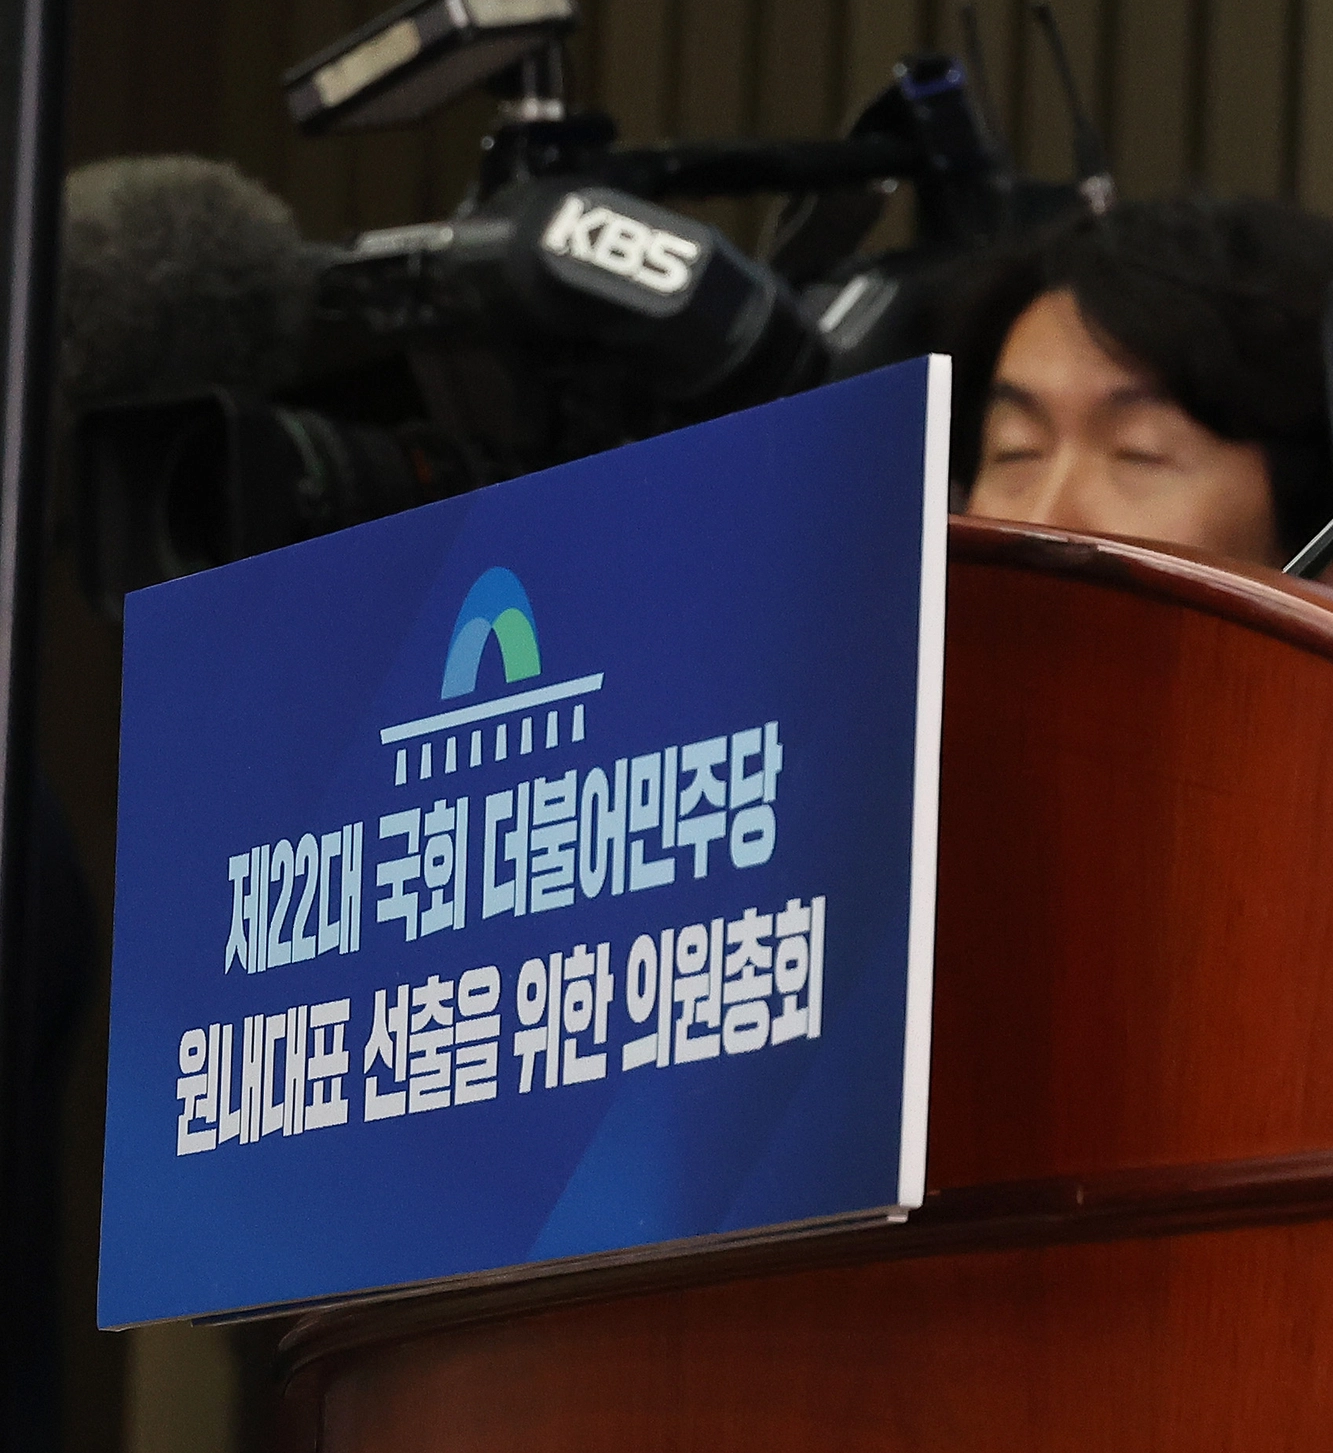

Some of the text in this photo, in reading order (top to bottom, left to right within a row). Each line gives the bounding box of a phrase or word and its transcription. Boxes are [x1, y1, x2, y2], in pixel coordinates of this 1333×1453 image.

[545, 193, 699, 293] KBS
[225, 721, 783, 975] 제22대 국회 더불어민주당
[176, 895, 826, 1157] 원내대표 선출을 위한 의원총회
